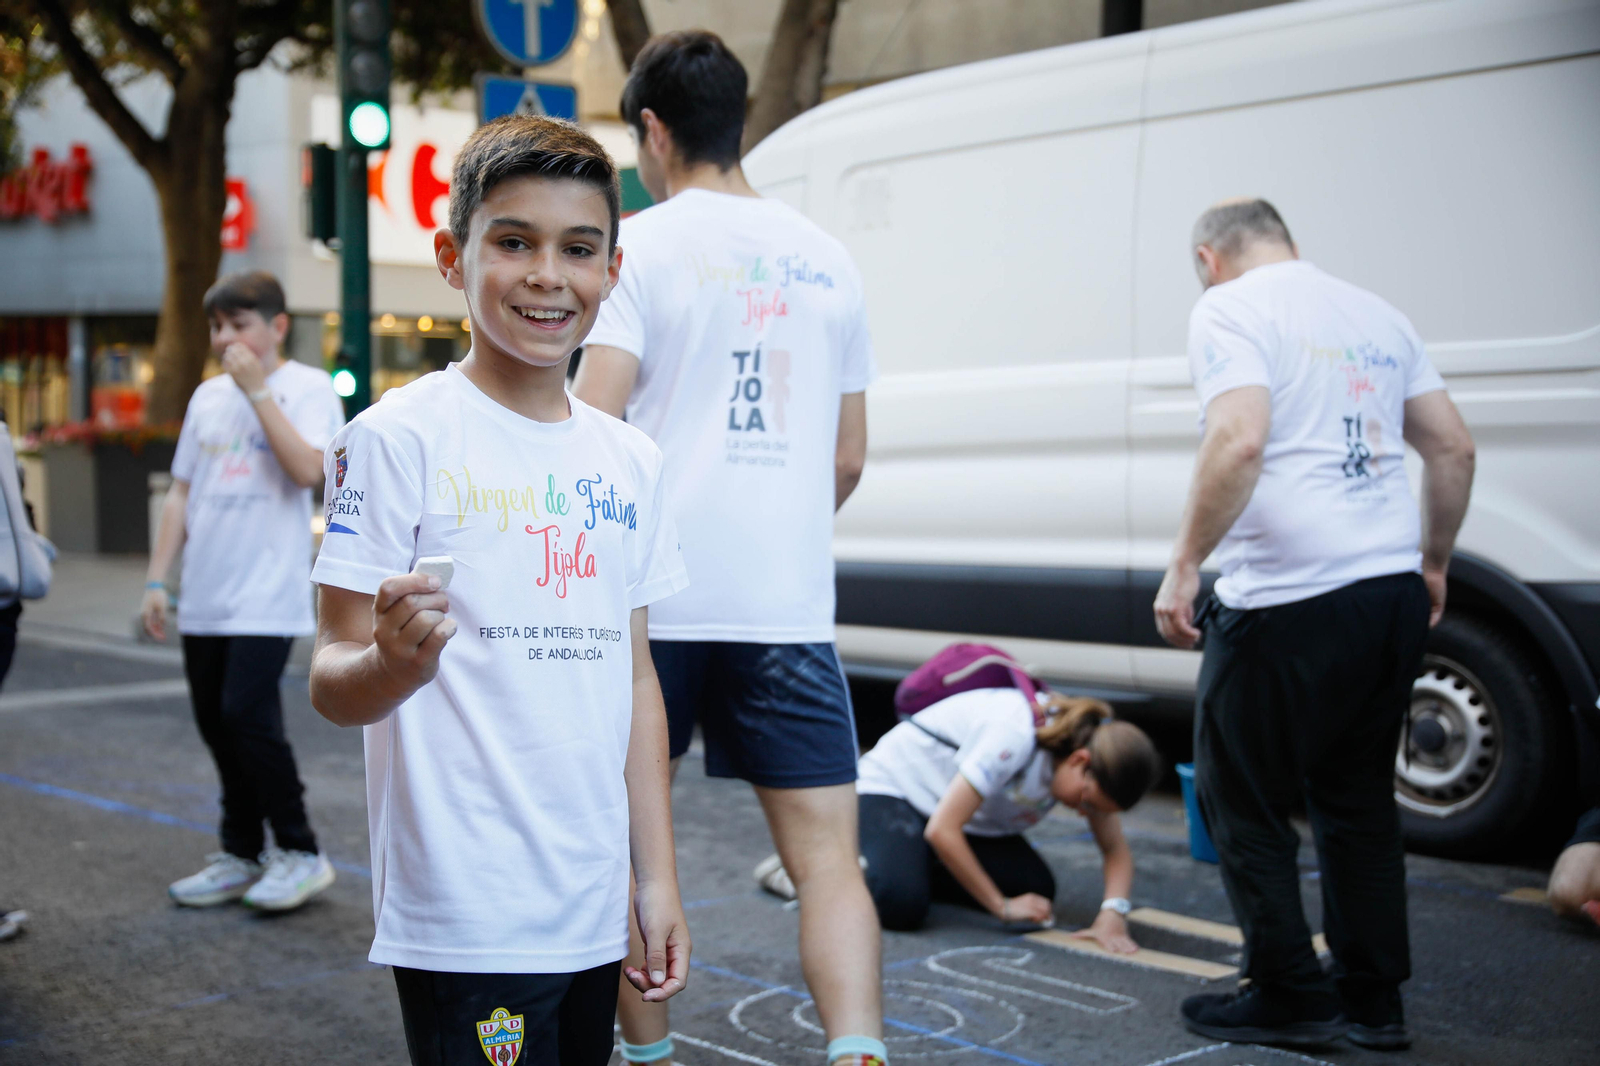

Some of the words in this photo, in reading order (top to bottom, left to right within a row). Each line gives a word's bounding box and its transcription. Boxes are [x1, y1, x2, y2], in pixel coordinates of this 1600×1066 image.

[729, 376, 762, 402] JO
[728, 407, 766, 432] LA
[436, 465, 540, 533] Virgen
[545, 473, 571, 516] de
[479, 626, 521, 639] FIESTA
[524, 626, 539, 639] DE
[528, 648, 543, 660] DE
[547, 646, 604, 661] ANDALUCÍA
[483, 1024, 493, 1033] U
[510, 1020, 519, 1028] D
[485, 1033, 520, 1044] ALMERIA
